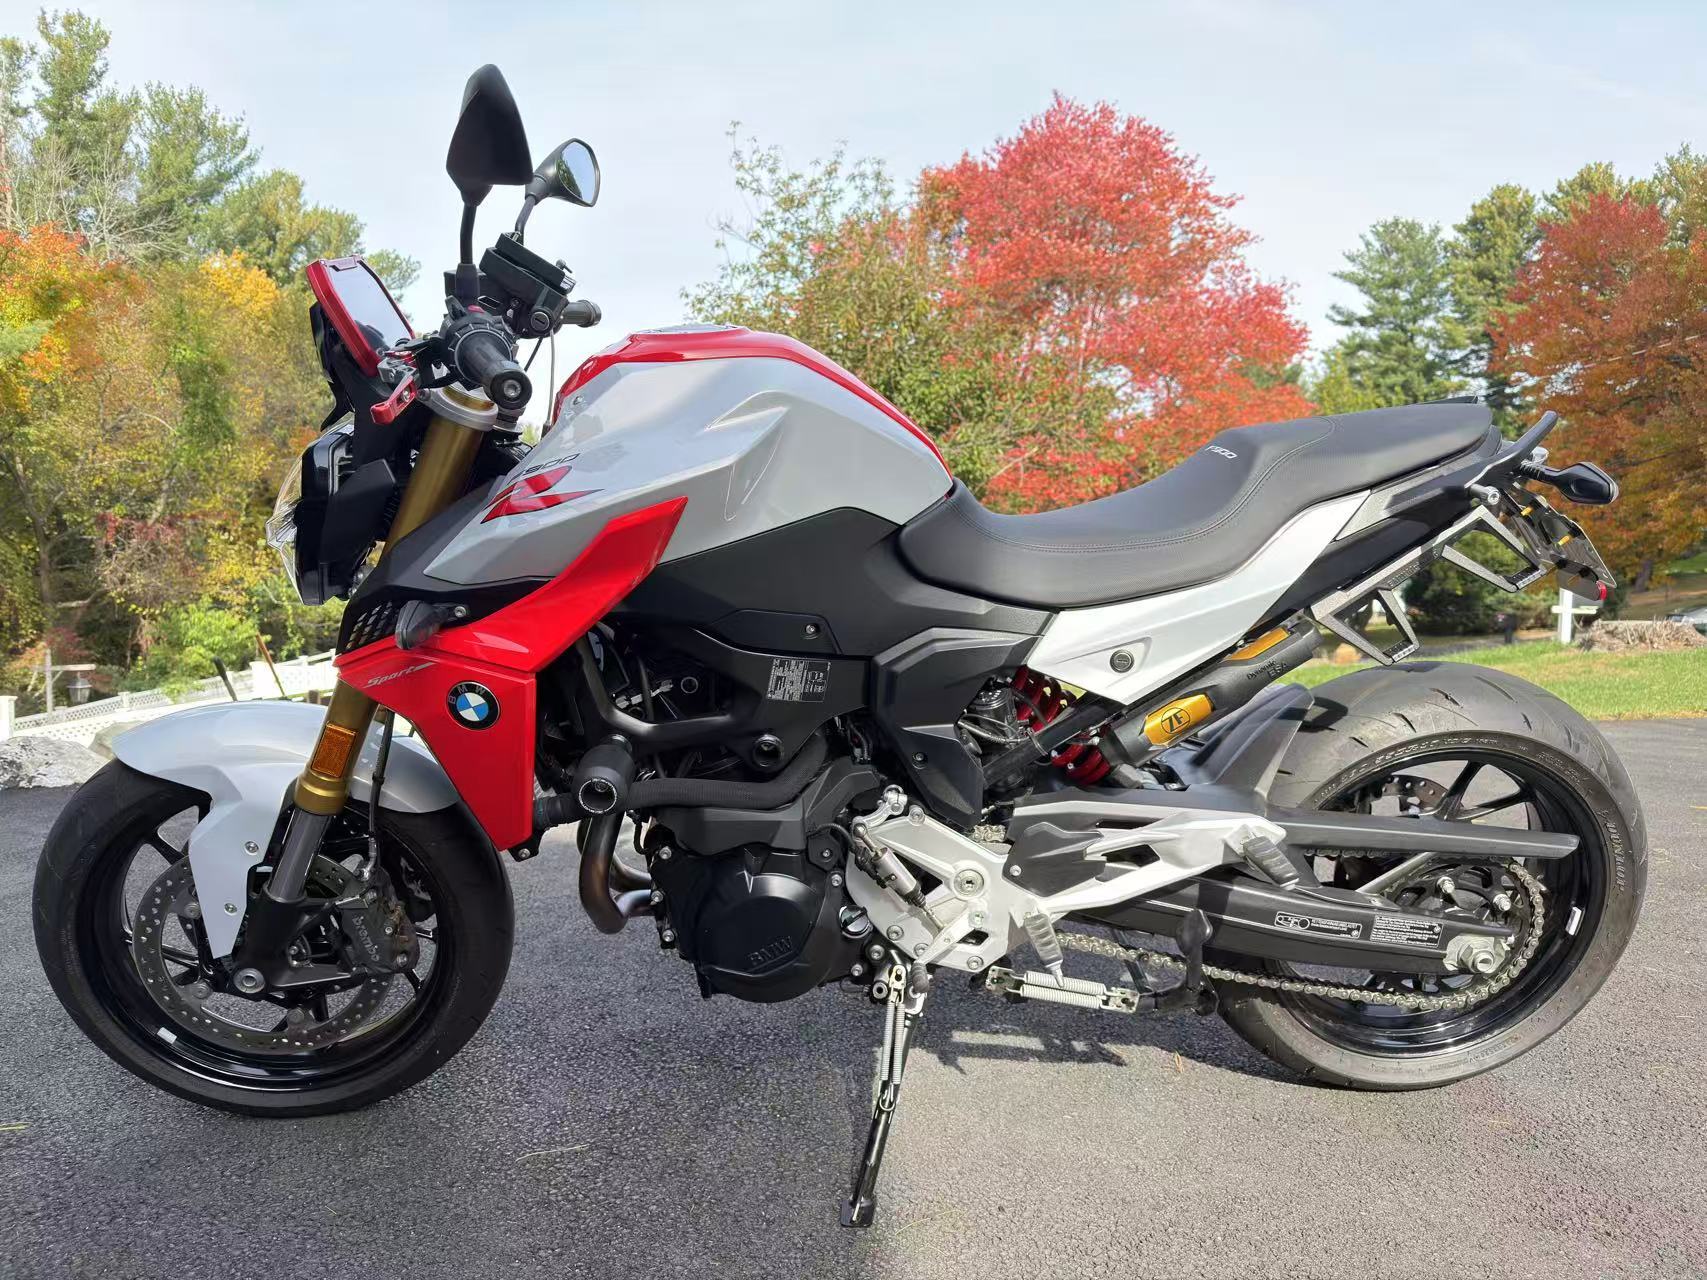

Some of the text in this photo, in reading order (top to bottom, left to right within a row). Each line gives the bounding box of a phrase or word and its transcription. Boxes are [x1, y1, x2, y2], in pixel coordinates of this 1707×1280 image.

[363, 661, 437, 688] Sport
[1163, 709, 1187, 734] ZF
[352, 915, 380, 961] brembo
[748, 936, 793, 965] BMW
